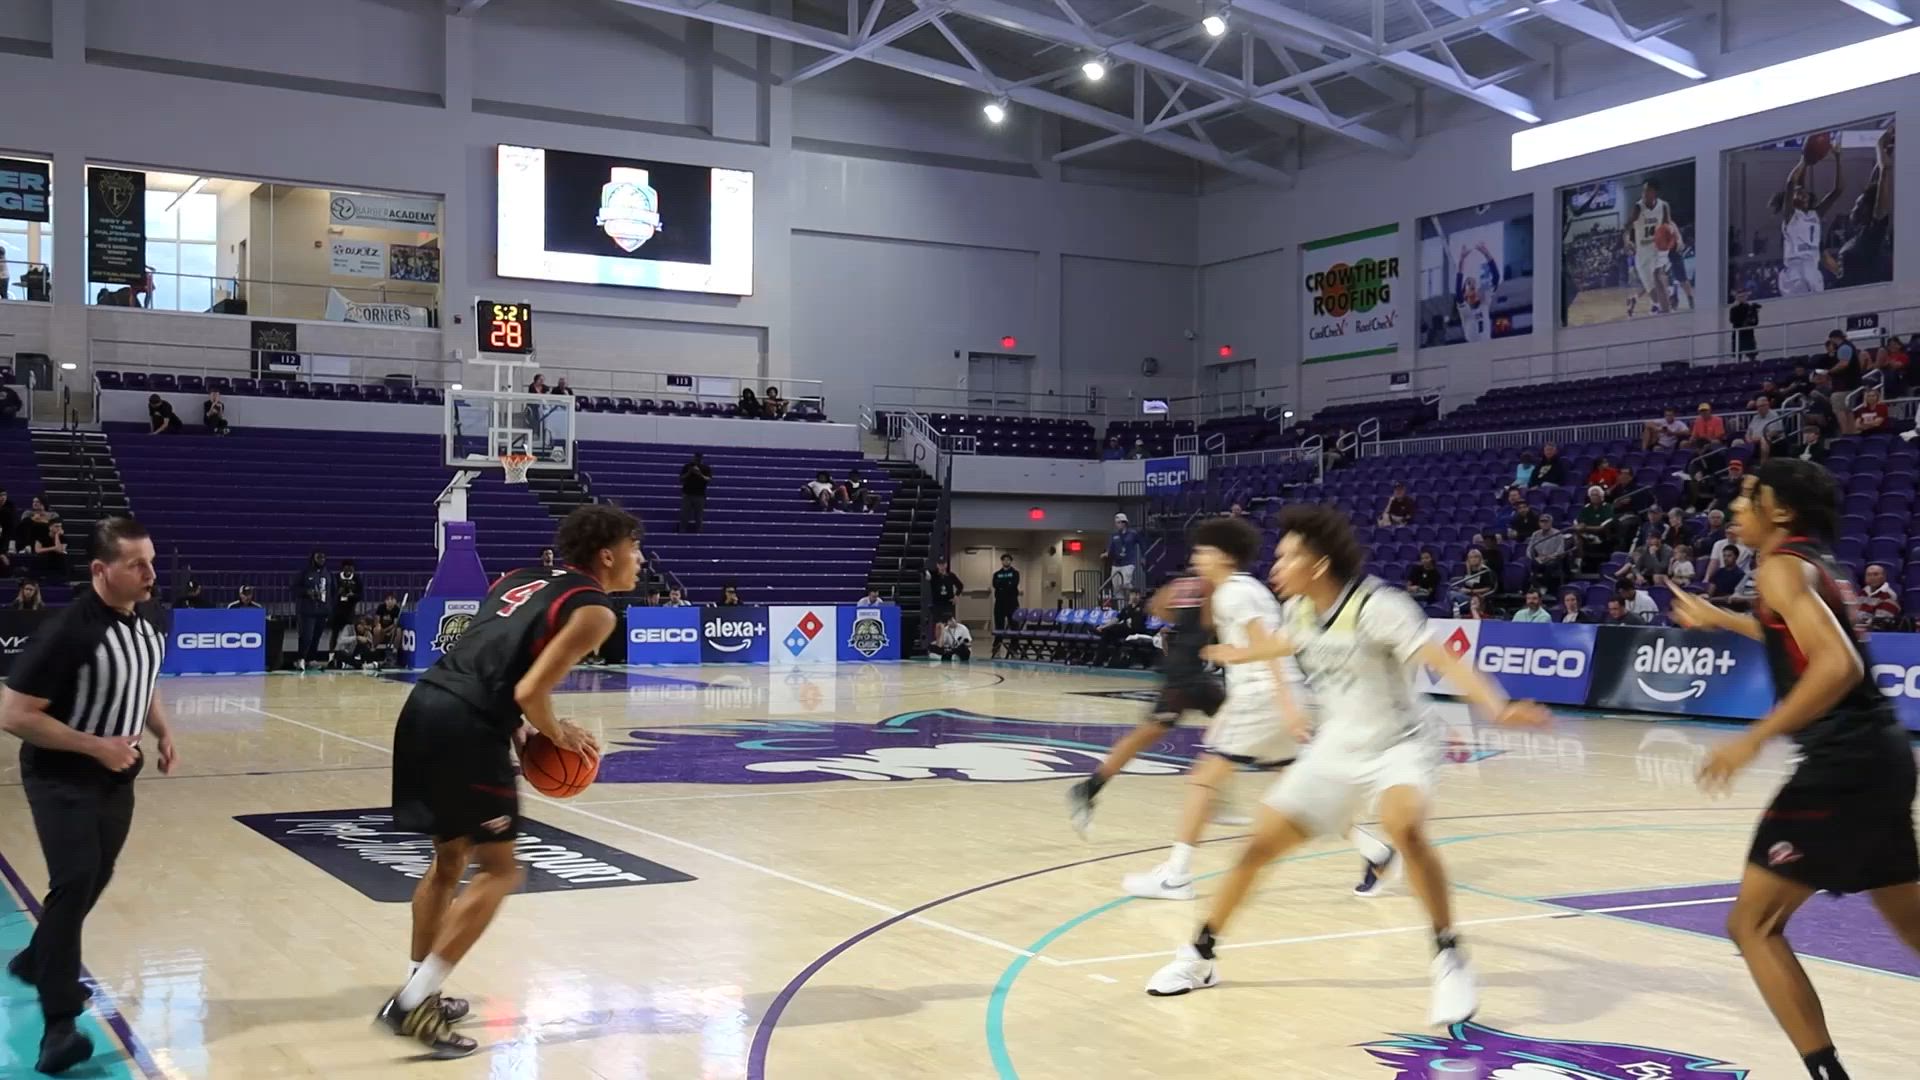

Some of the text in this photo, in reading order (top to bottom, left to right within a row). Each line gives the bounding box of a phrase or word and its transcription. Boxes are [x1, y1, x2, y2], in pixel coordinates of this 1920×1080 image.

[389, 210, 436, 221] ACADEMY
[1305, 257, 1399, 293] CROWTHER
[1313, 284, 1391, 317] ROOFING
[493, 304, 528, 322] 5:21
[1857, 317, 1873, 328] 116
[491, 320, 522, 348] 28
[281, 354, 296, 364] 112
[496, 579, 550, 617] 4
[630, 627, 698, 643] GEICO
[704, 617, 767, 638] alexa+
[177, 632, 262, 649] GEICO
[1478, 645, 1586, 678] GEICO
[1634, 637, 1736, 676] alexa+
[512, 844, 648, 883] COURT
